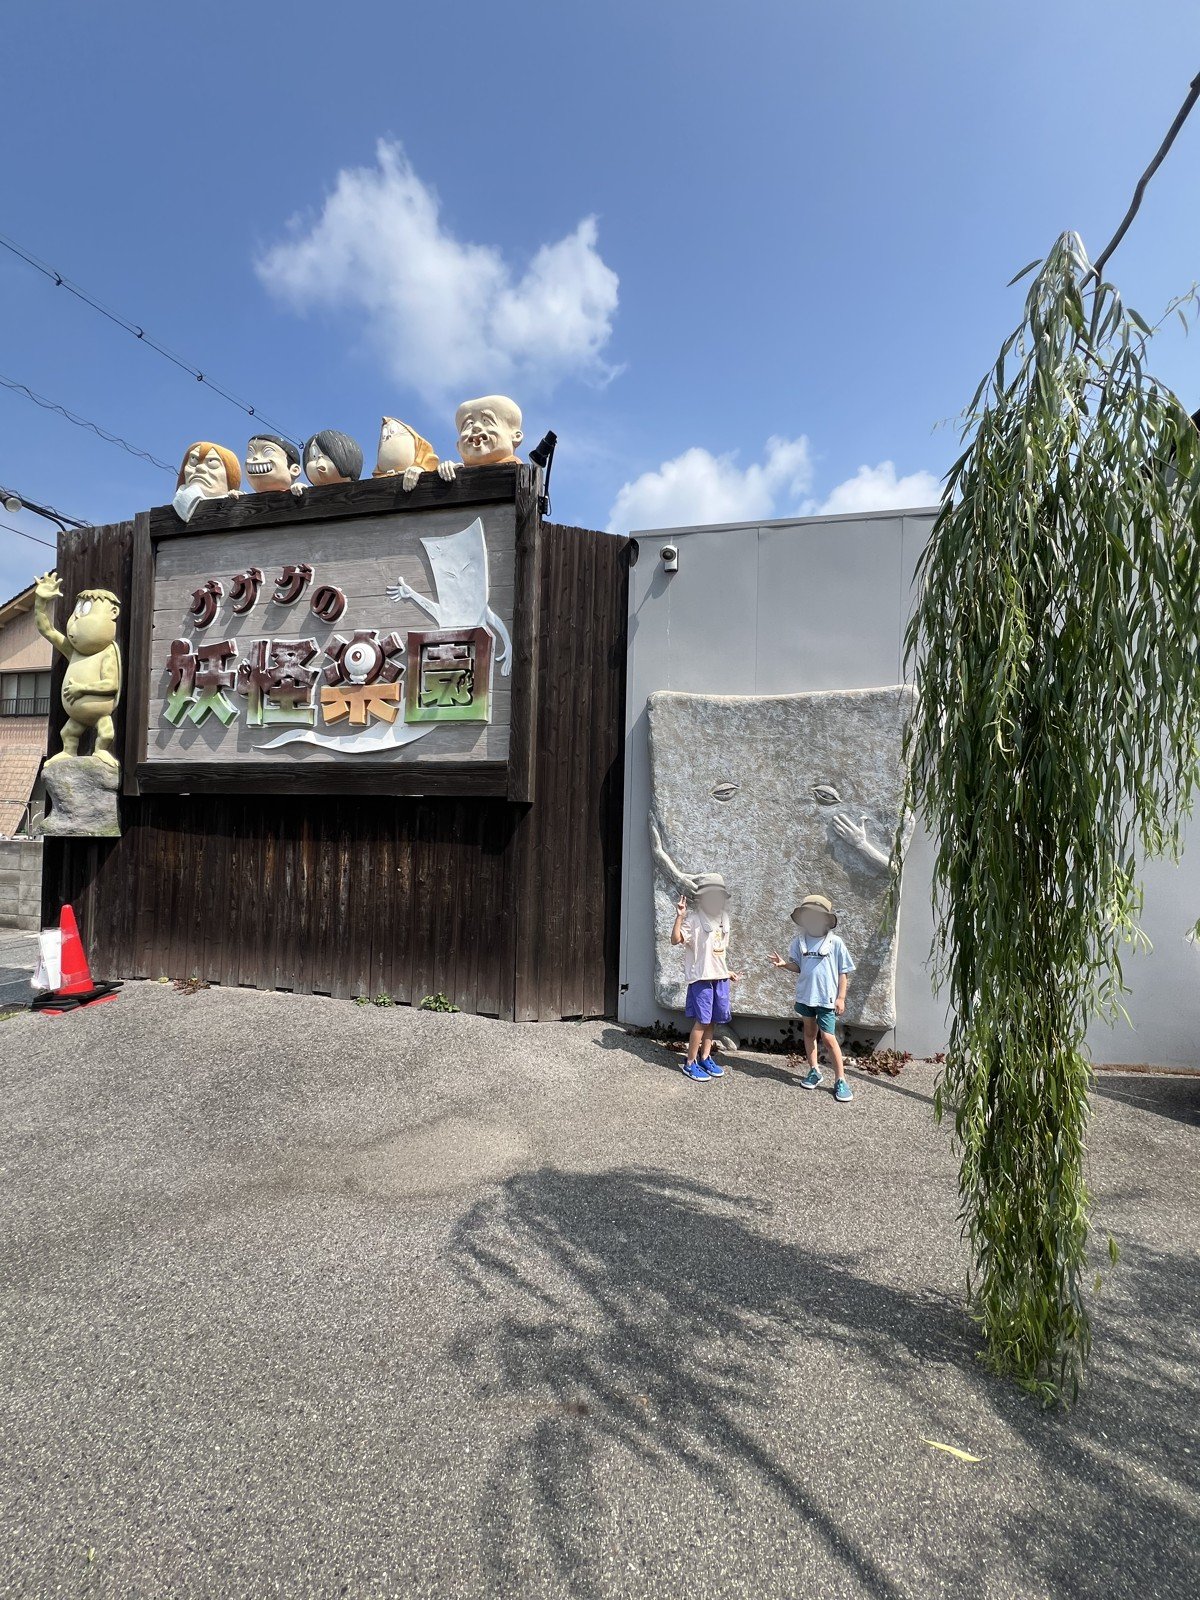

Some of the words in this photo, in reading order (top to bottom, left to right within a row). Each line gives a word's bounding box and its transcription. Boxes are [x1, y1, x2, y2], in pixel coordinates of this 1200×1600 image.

[190, 563, 347, 630] ゲゲゲの
[164, 629, 495, 727] 妖怪楽園
